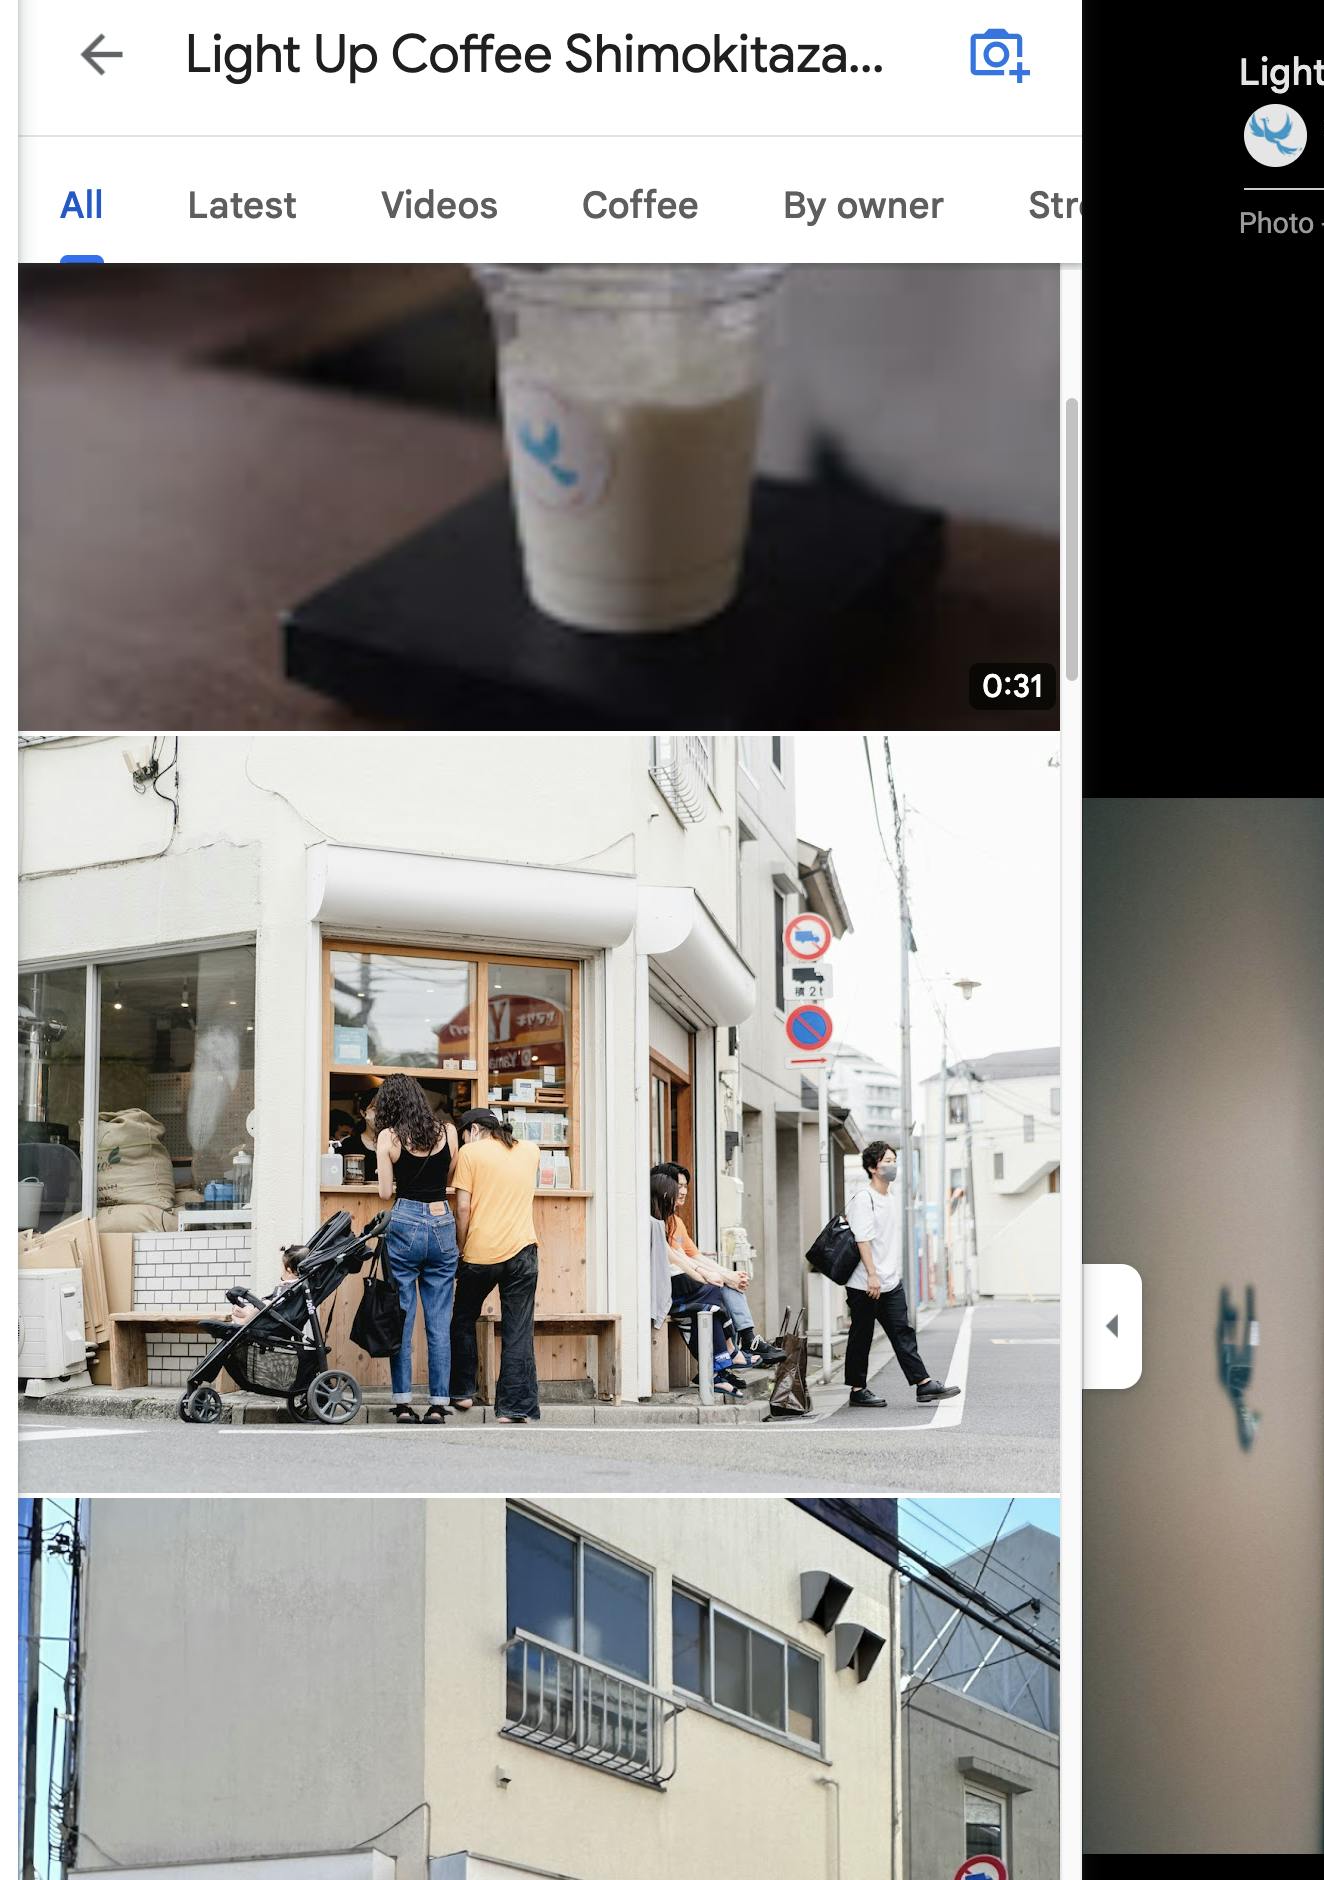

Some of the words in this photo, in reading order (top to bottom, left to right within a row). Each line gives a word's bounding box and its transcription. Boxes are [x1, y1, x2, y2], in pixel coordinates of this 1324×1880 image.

[188, 32, 301, 85] Light
[315, 33, 378, 85] Up
[392, 32, 552, 74] Coffee
[565, 32, 883, 74] Shimokitaza...
[59, 188, 103, 220] All
[188, 190, 297, 220] Latest
[380, 188, 498, 220] Videos
[582, 188, 699, 220] Coffee
[785, 190, 827, 227] By
[837, 197, 945, 220] owner
[1028, 190, 1082, 220] Str
[1240, 210, 1314, 234] Photo
